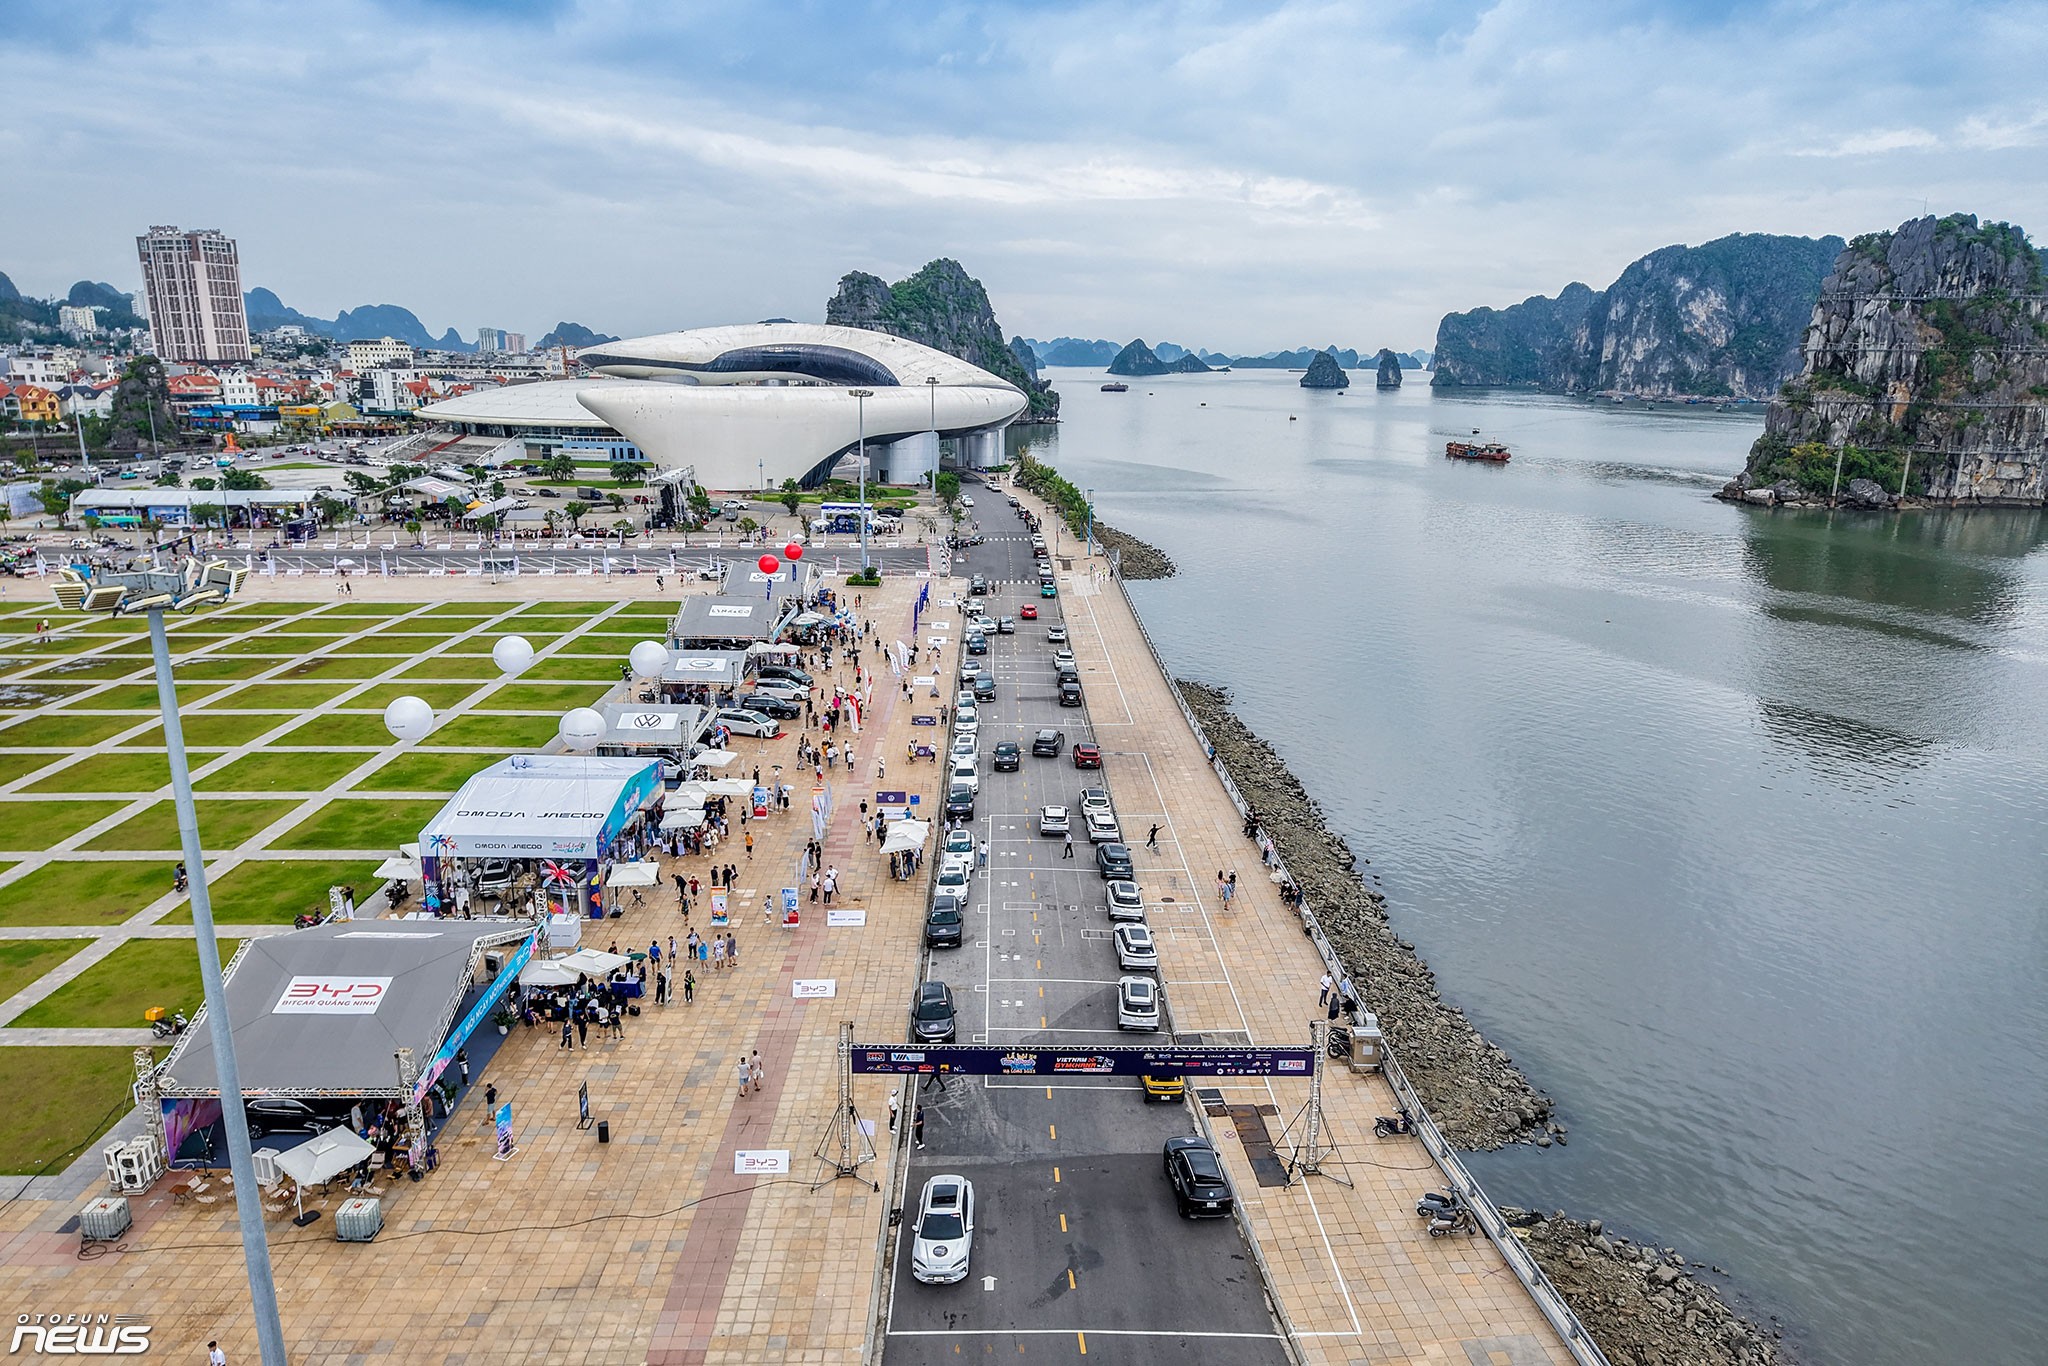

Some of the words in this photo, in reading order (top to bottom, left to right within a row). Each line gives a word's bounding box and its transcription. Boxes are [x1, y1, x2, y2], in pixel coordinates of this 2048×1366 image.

[456, 810, 526, 818] OMODA
[288, 983, 383, 998] BYD
[745, 1158, 778, 1166] BYD
